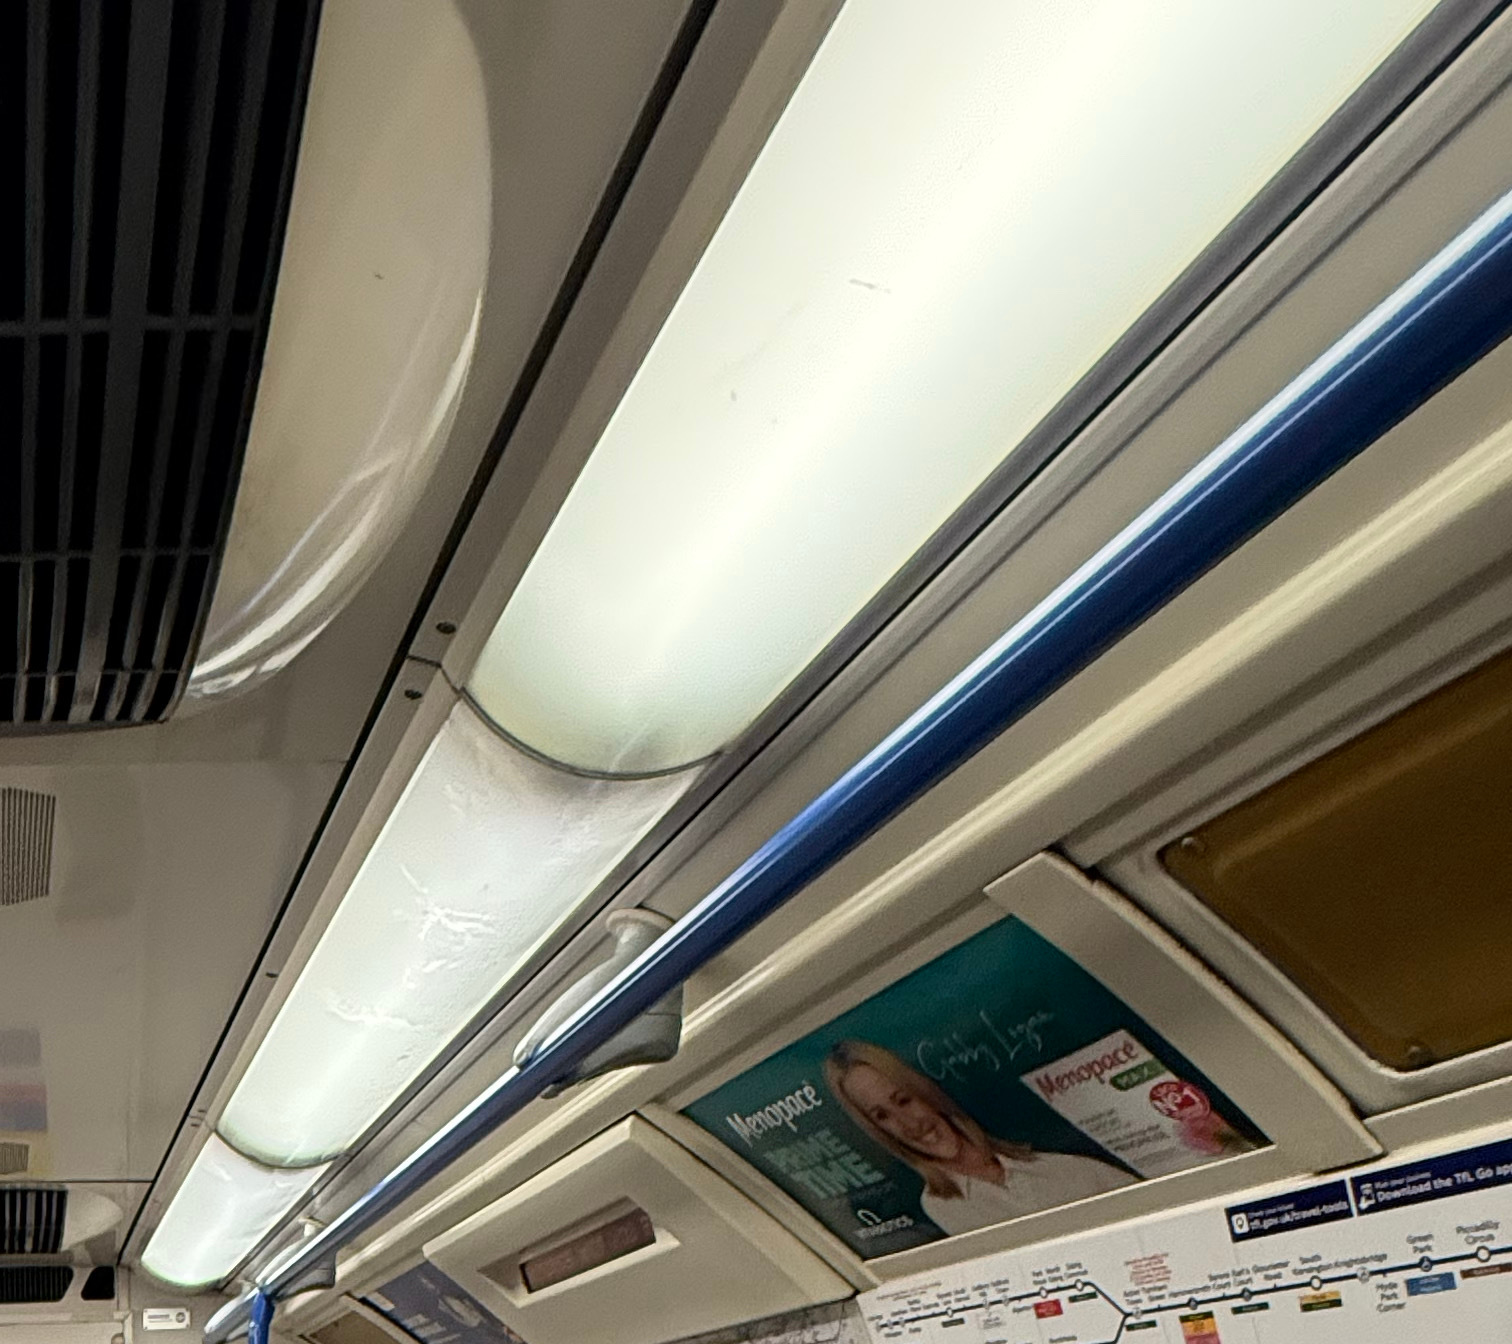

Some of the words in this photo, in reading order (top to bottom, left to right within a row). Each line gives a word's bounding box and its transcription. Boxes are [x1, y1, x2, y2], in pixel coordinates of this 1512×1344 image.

[726, 1080, 823, 1148] Menopace
[764, 1129, 851, 1174] PRIME
[790, 1153, 885, 1199] TIME
[1377, 1180, 1433, 1203] Download
[1433, 1176, 1453, 1190] the
[1475, 1166, 1494, 1181] Go
